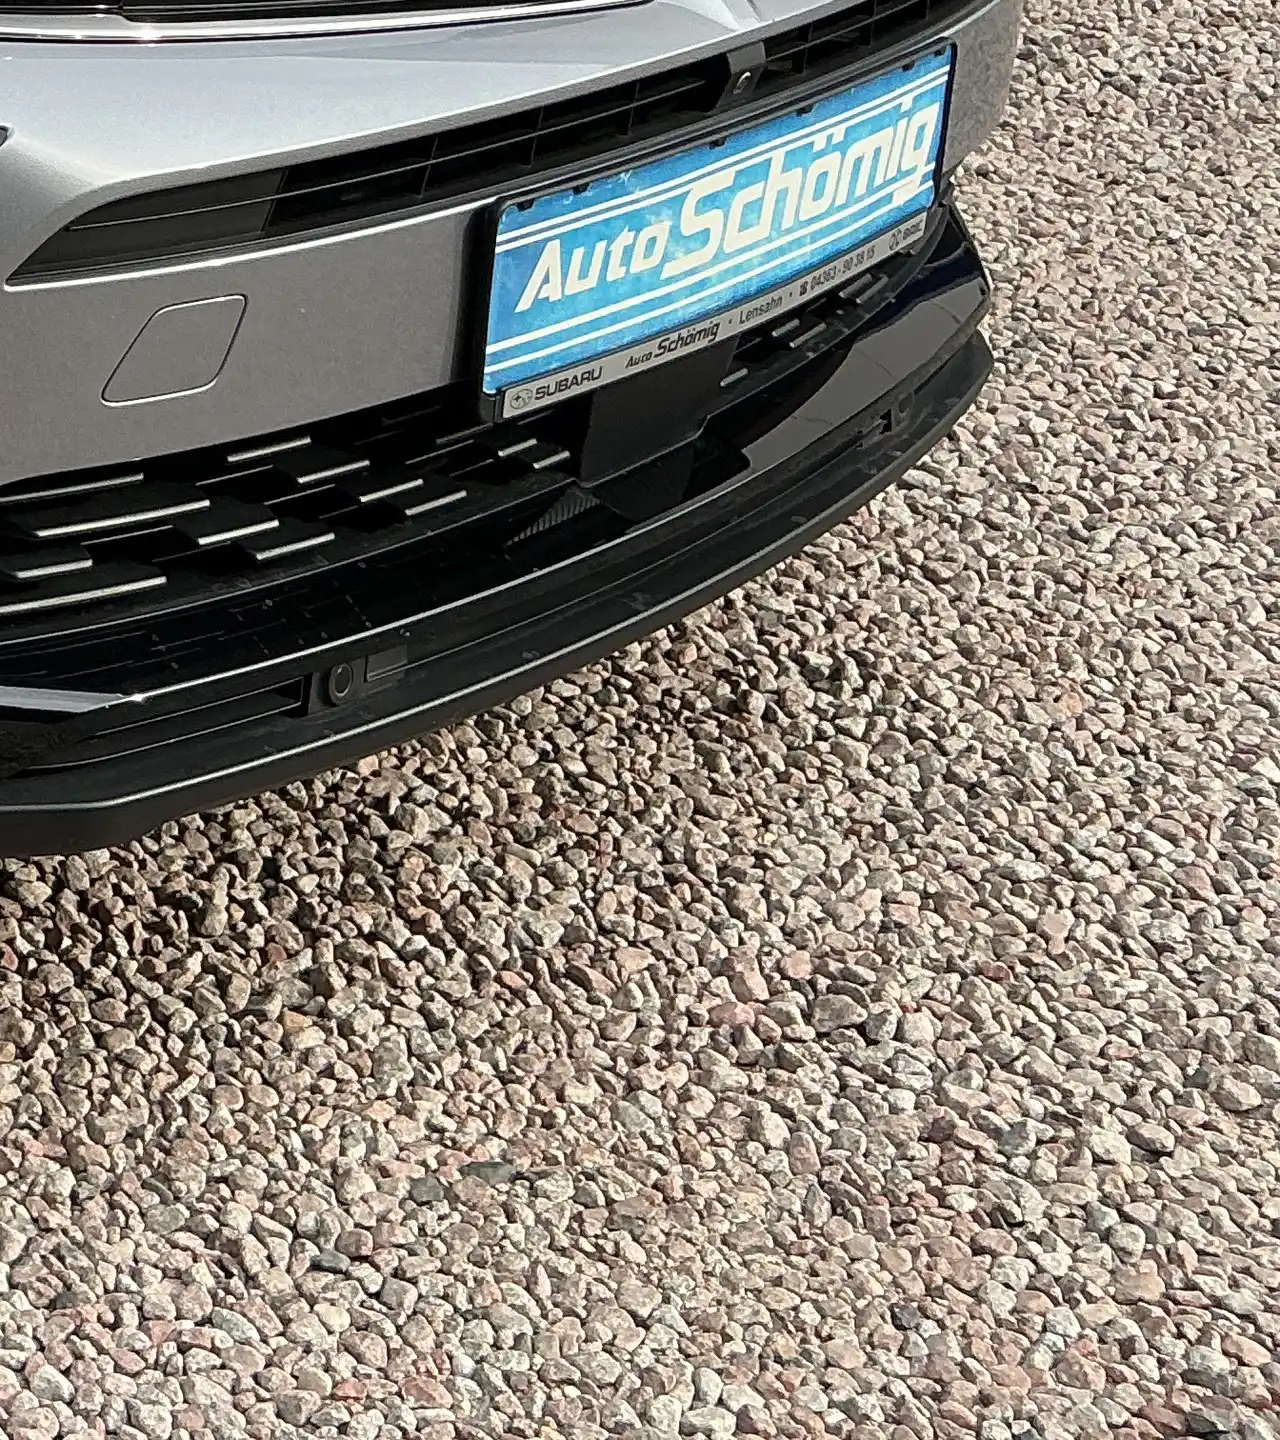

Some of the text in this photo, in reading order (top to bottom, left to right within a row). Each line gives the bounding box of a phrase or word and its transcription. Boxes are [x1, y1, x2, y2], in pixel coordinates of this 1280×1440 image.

[534, 365, 604, 401] SUBARU
[653, 321, 721, 359] Schömig
[738, 295, 783, 325] Lensahn
